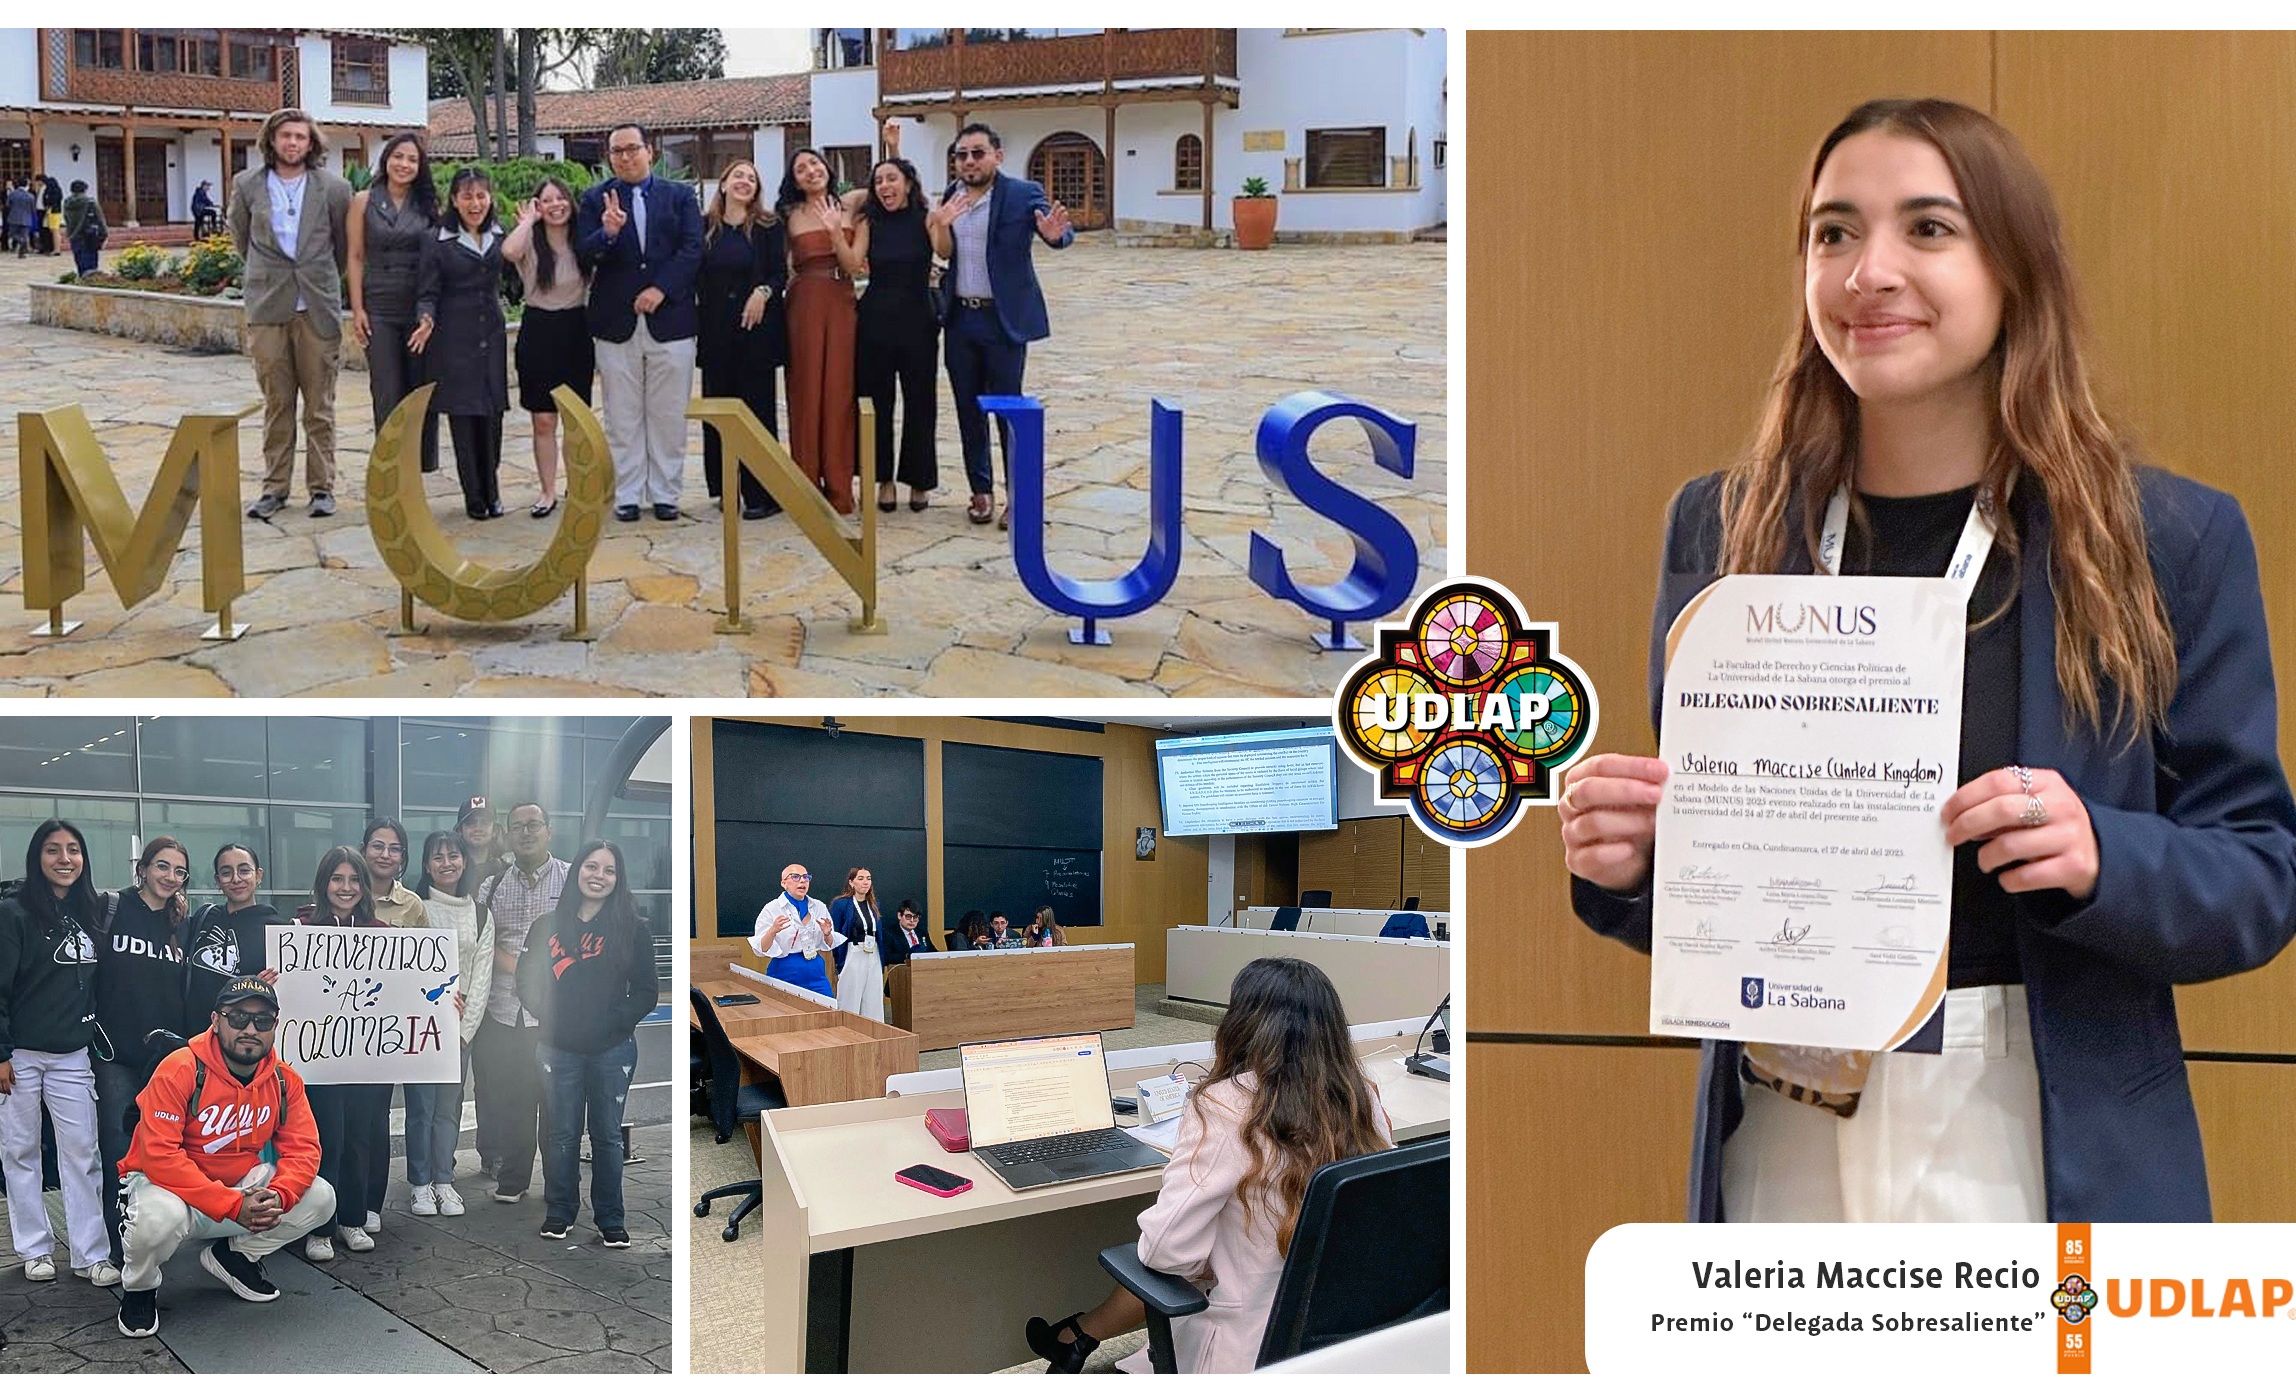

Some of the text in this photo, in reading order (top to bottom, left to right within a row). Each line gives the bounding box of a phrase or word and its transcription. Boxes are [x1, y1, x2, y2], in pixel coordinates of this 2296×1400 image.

[17, 382, 1419, 623] MUNUS
[1746, 602, 1876, 635] MUNUS
[1713, 660, 1724, 669] La
[1726, 661, 1761, 670] Facultad
[1762, 662, 1773, 670] de
[1775, 662, 1810, 671] Derecho
[1812, 664, 1818, 673] y
[1820, 663, 1855, 672] Ciencias
[1895, 664, 1907, 673] de
[1708, 672, 1911, 686] La Universidad de La Sabana otorga el premio al
[1680, 692, 1939, 715] DELEGADO SOBRESALIENTE
[1682, 752, 1738, 776] Valeria
[1753, 758, 1822, 779] Maccise
[1884, 758, 1943, 788] Kingdom)
[1687, 783, 1695, 791] el
[1698, 784, 1729, 793] Modelo
[1731, 784, 1742, 793] de
[1745, 785, 1756, 793] las
[1759, 786, 1796, 795] Naciones
[1800, 787, 1828, 796] Unidas
[1831, 787, 1842, 796] de
[1845, 788, 1852, 797] la
[1856, 788, 1907, 799] Universidad
[1909, 790, 1921, 799] de
[1924, 791, 1935, 800] La
[1673, 794, 1934, 812] Sabana (MUNUS) 2025 evento realizado en las instalaciones de
[1673, 806, 1680, 815] la
[1682, 807, 1729, 816] universidad
[1730, 808, 1742, 817] del
[1744, 809, 1754, 817] 24
[1756, 809, 1764, 818] al
[1765, 809, 1775, 818] 27
[1776, 810, 1787, 819] de
[1788, 810, 1807, 819] abril
[1809, 811, 1822, 820] del
[1824, 812, 1860, 823] presente
[1692, 840, 1730, 850] Entregado
[1821, 846, 1828, 854] el
[1830, 846, 1839, 854] 27
[1840, 846, 1850, 855] de
[1851, 847, 1869, 856] abril
[1870, 848, 1883, 856] del
[279, 931, 449, 974] BIENVENIDOS
[338, 978, 365, 1011] A
[1768, 982, 1823, 992] Universidad de
[1768, 992, 1846, 1010] La Sabana
[281, 1014, 442, 1067] COLOMBIA
[154, 1110, 180, 1123] UDLAP
